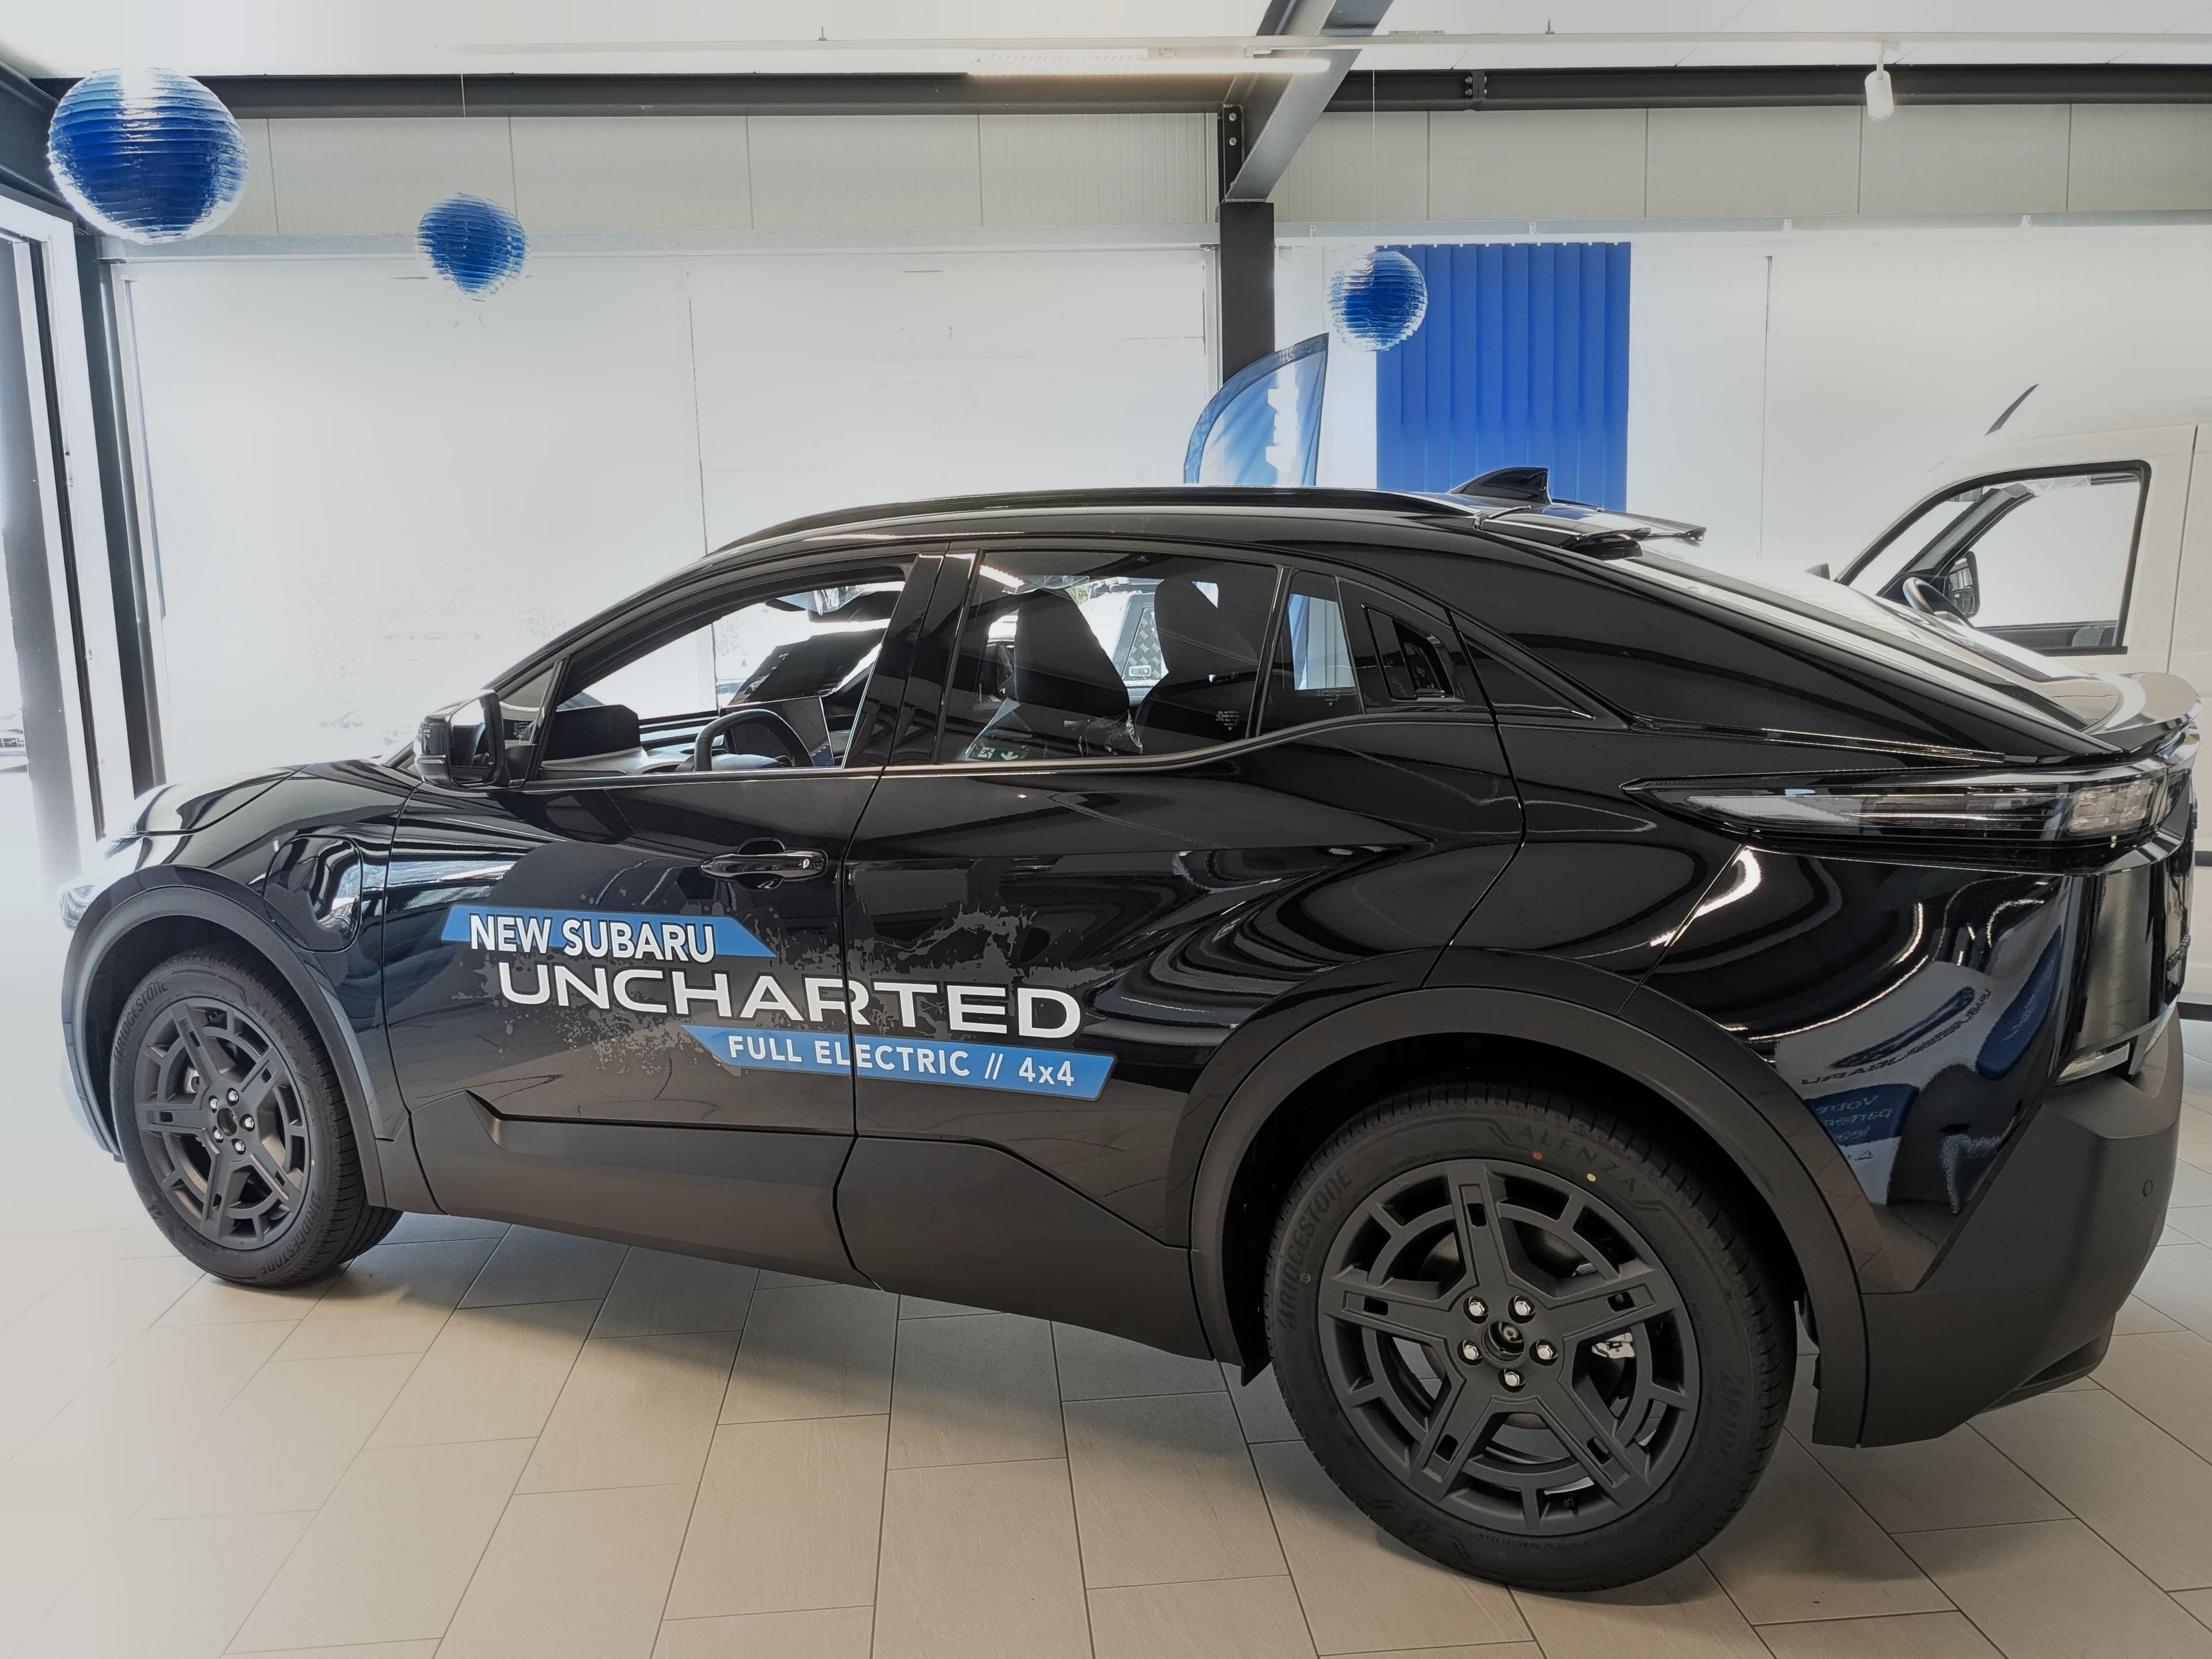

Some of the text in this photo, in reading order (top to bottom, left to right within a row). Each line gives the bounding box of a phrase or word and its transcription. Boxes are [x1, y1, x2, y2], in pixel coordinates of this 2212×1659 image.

[469, 914, 715, 963] NEW SUBARU
[498, 961, 1081, 1039] UNCHARTED
[728, 1035, 1075, 1087] FULL ELECTRIC // 4x4
[1517, 1124, 1636, 1192] ALENZA
[1277, 1165, 1353, 1330] BRIDGESTONE
